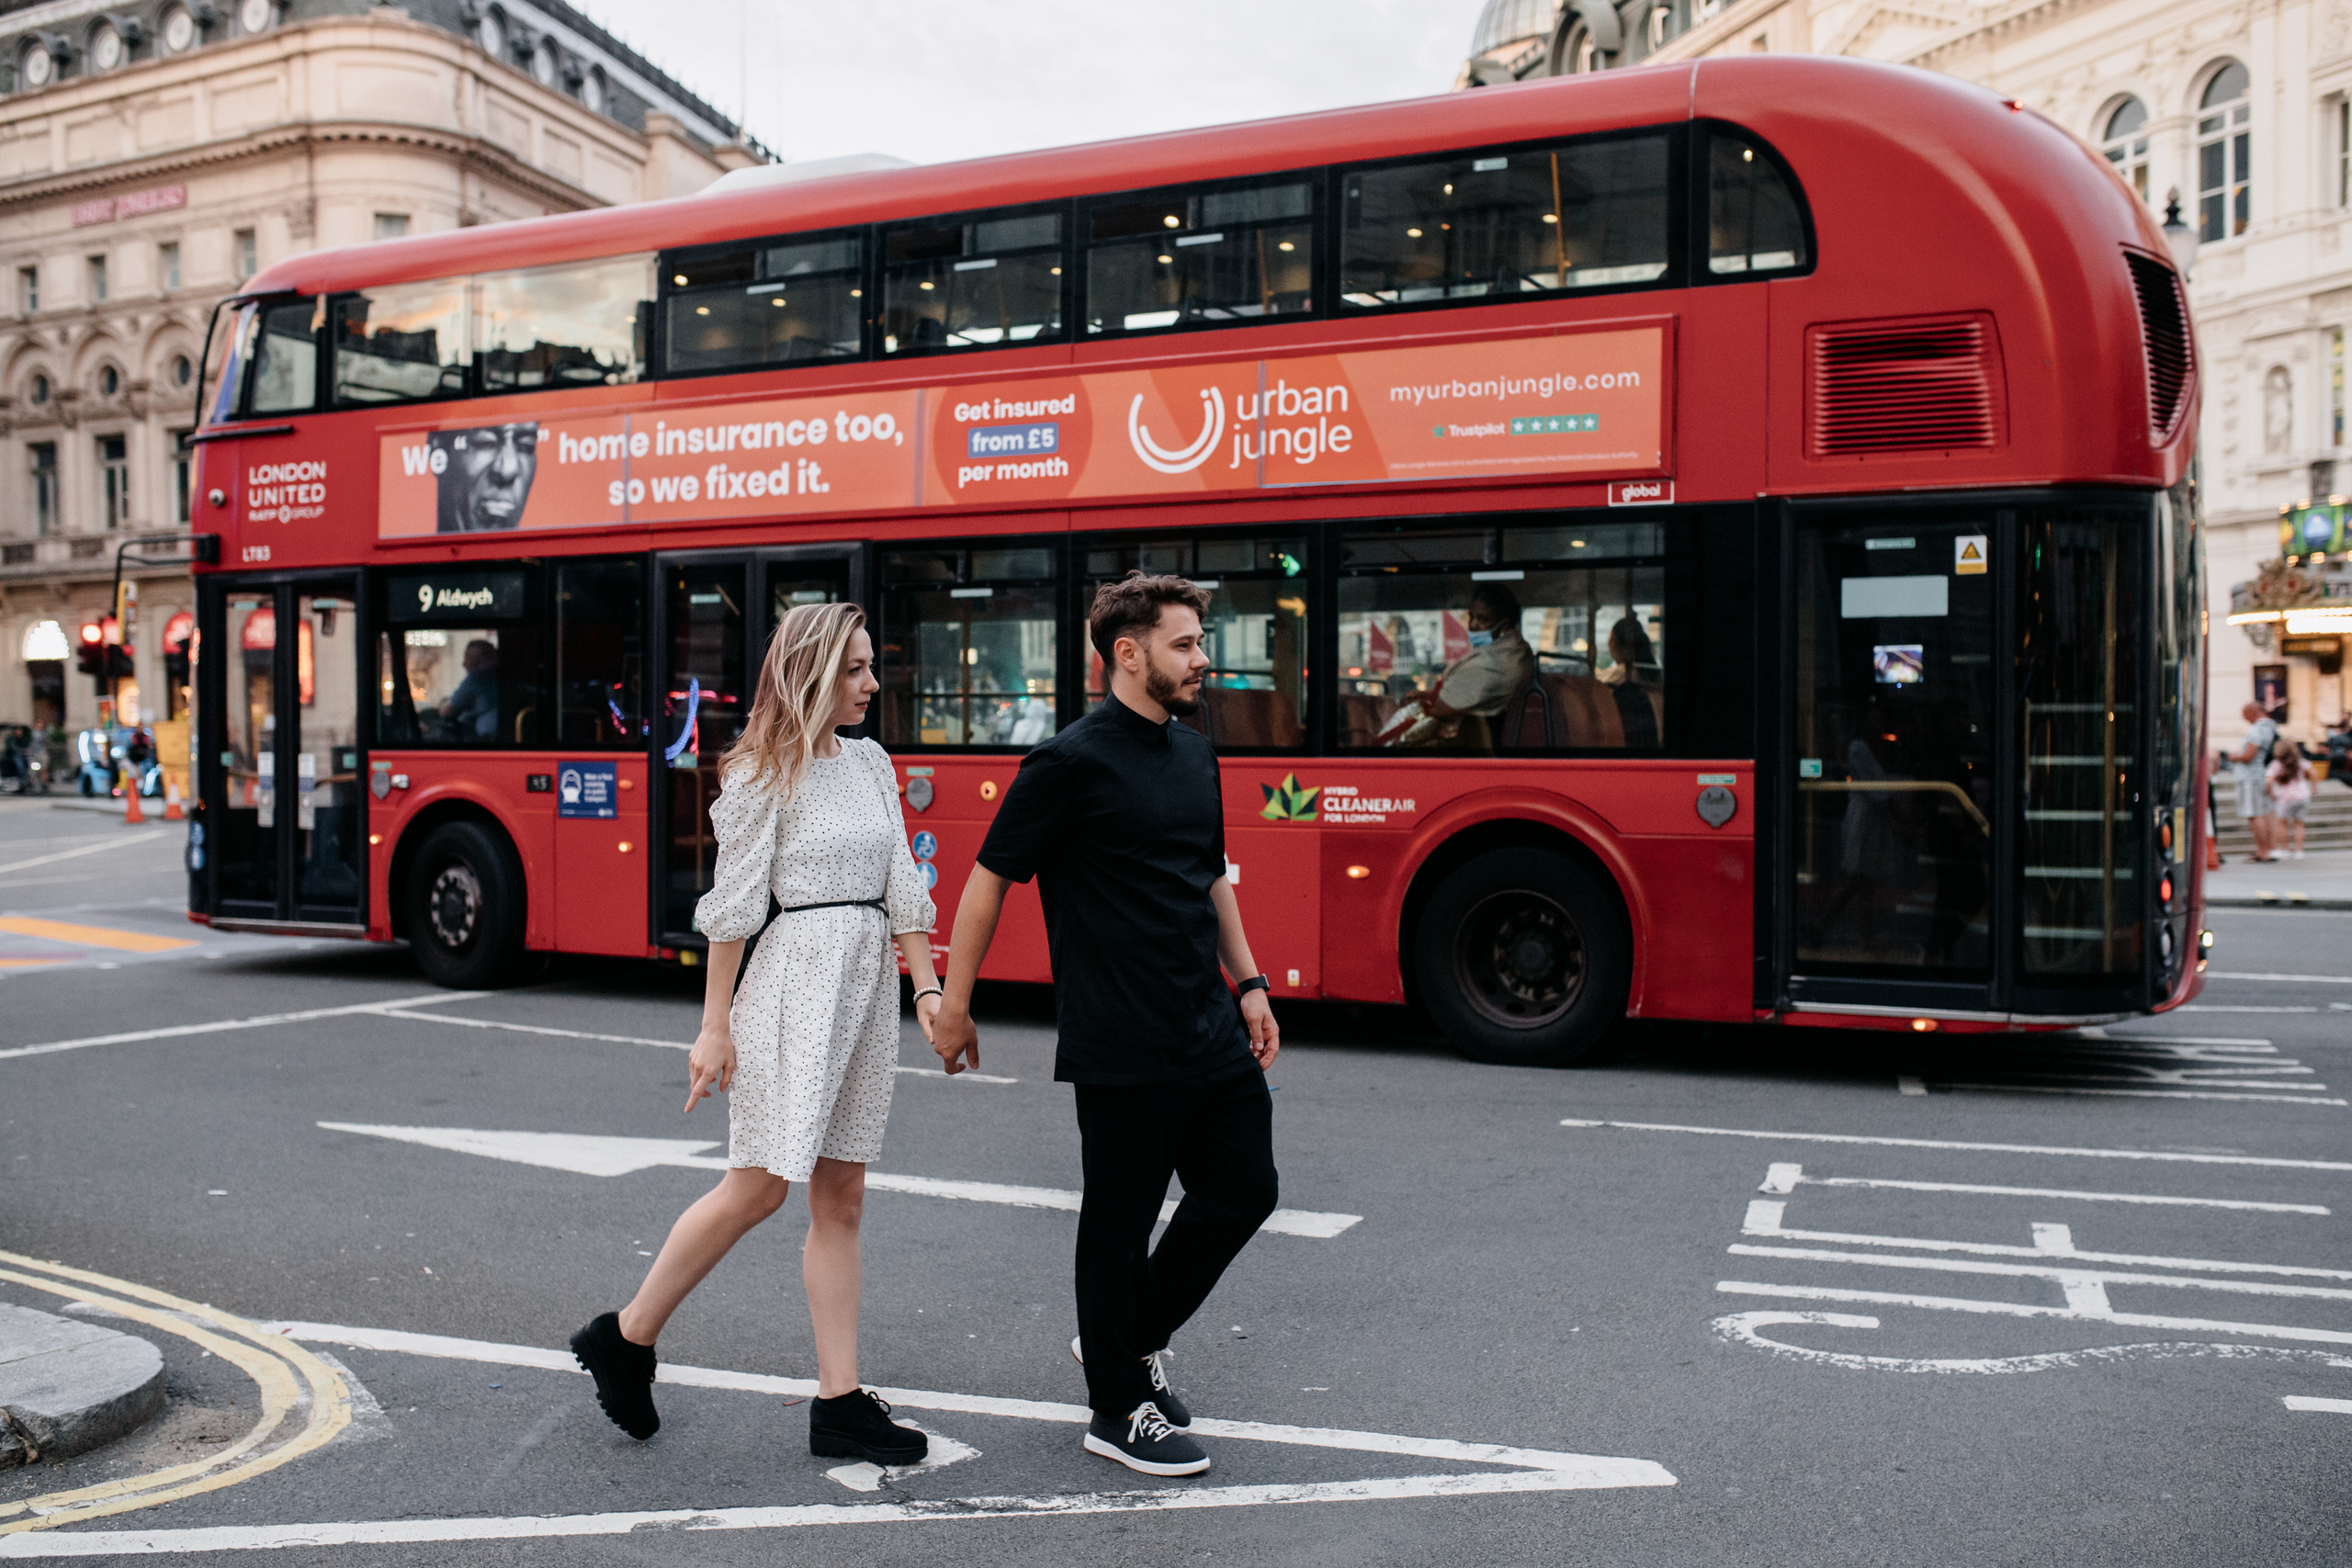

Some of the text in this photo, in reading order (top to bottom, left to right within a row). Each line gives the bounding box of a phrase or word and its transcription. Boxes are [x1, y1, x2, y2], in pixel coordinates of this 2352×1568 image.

[1237, 379, 1349, 421] urban
[1390, 371, 1641, 406] myurbanjungle.com
[954, 393, 1075, 422] Get insured
[401, 411, 904, 476] We home insurance too,
[971, 427, 1055, 453] from £5
[1229, 416, 1353, 470] jungle
[1449, 423, 1505, 438] Trustpilot
[248, 459, 327, 486] LONDON
[608, 457, 831, 506] so we fixed it.
[958, 456, 1069, 489] per month
[248, 482, 326, 508] UNITED
[1622, 482, 1661, 502] global
[418, 583, 493, 613] 9 Aldwych
[1323, 786, 1359, 796] HYBRID
[1323, 814, 1385, 823] FOR LONDON
